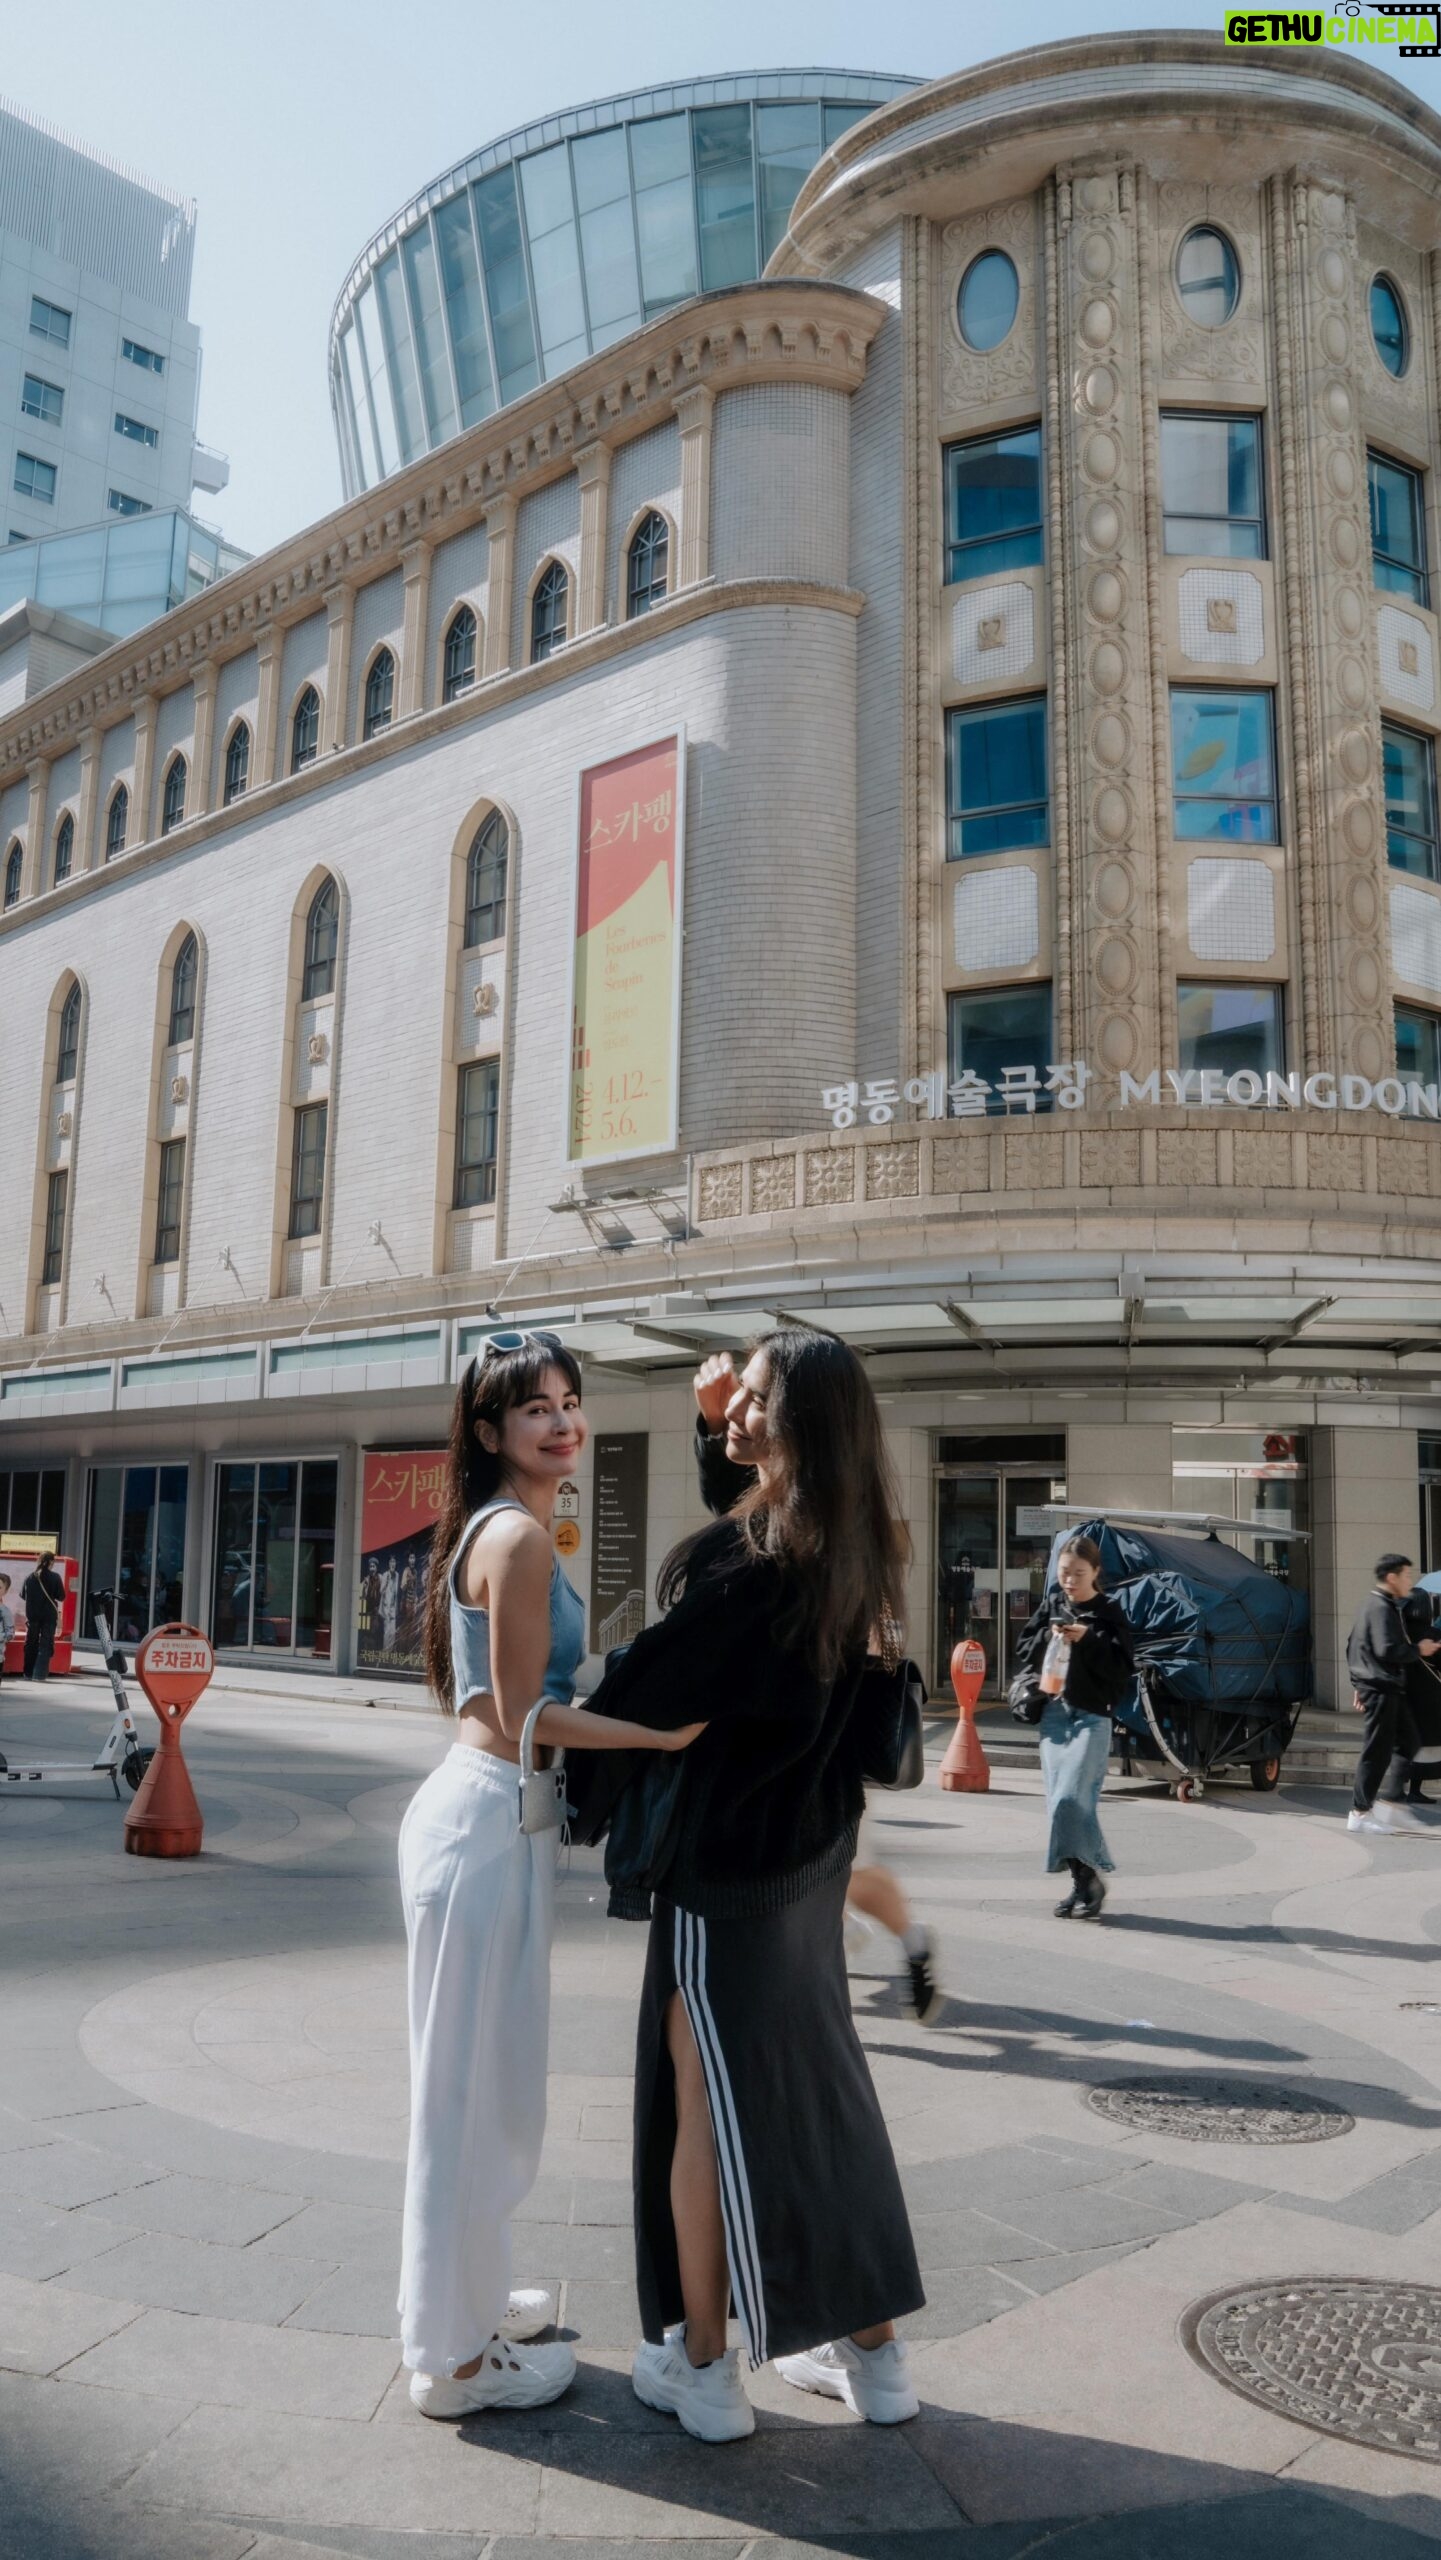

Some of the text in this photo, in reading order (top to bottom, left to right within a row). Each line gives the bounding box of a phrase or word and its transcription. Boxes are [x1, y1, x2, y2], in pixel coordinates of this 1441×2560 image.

[584, 789, 672, 853] 스카팽
[821, 1061, 1092, 1128] 명동예술극장
[367, 1463, 447, 1509] 스카팽
[561, 1498, 572, 1508] 35
[151, 1650, 206, 1669] 주차금지
